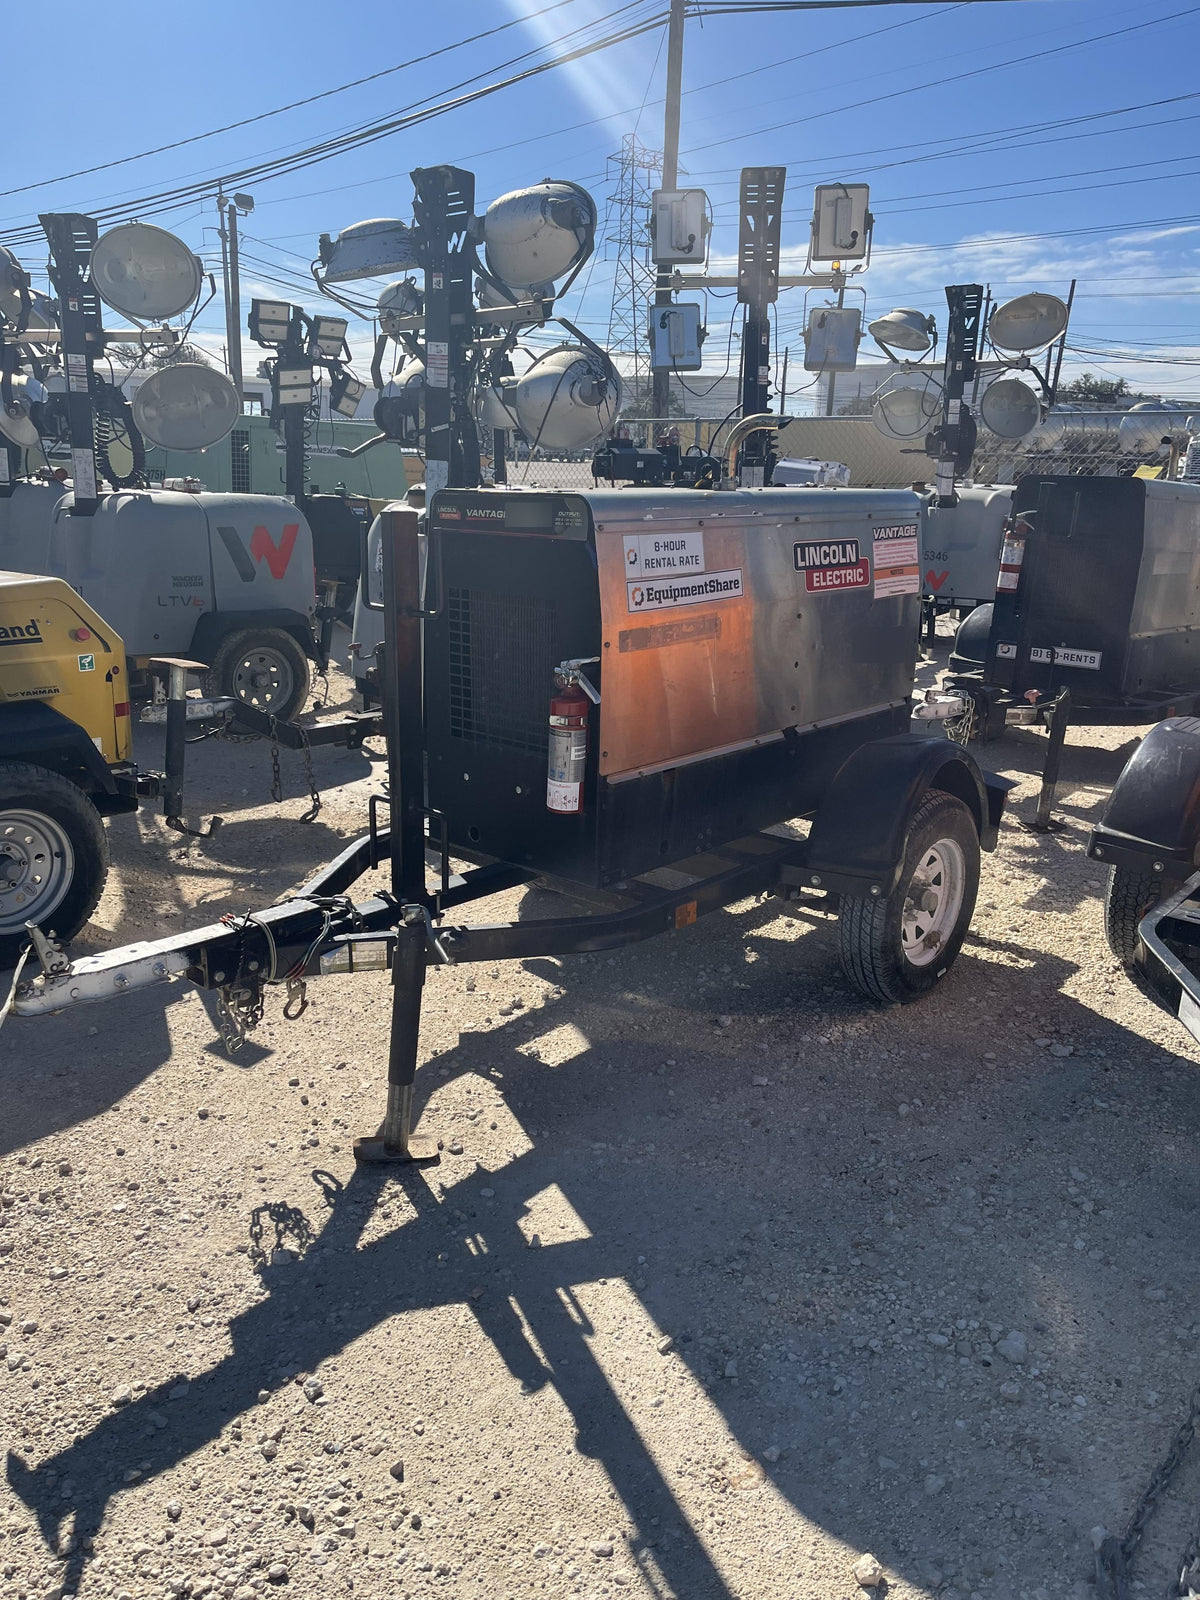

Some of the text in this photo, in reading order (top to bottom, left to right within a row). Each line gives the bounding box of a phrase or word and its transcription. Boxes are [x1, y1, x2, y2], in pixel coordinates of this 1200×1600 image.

[873, 525, 917, 540] VANTAGE
[654, 540, 686, 552] 8-HOUR
[644, 555, 700, 569] RENTAL RATE
[796, 543, 857, 567] LINCOLN
[812, 568, 864, 588] ELECTRIC
[646, 578, 740, 604] EquipmentShare
[20, 688, 60, 697] YANMAR
